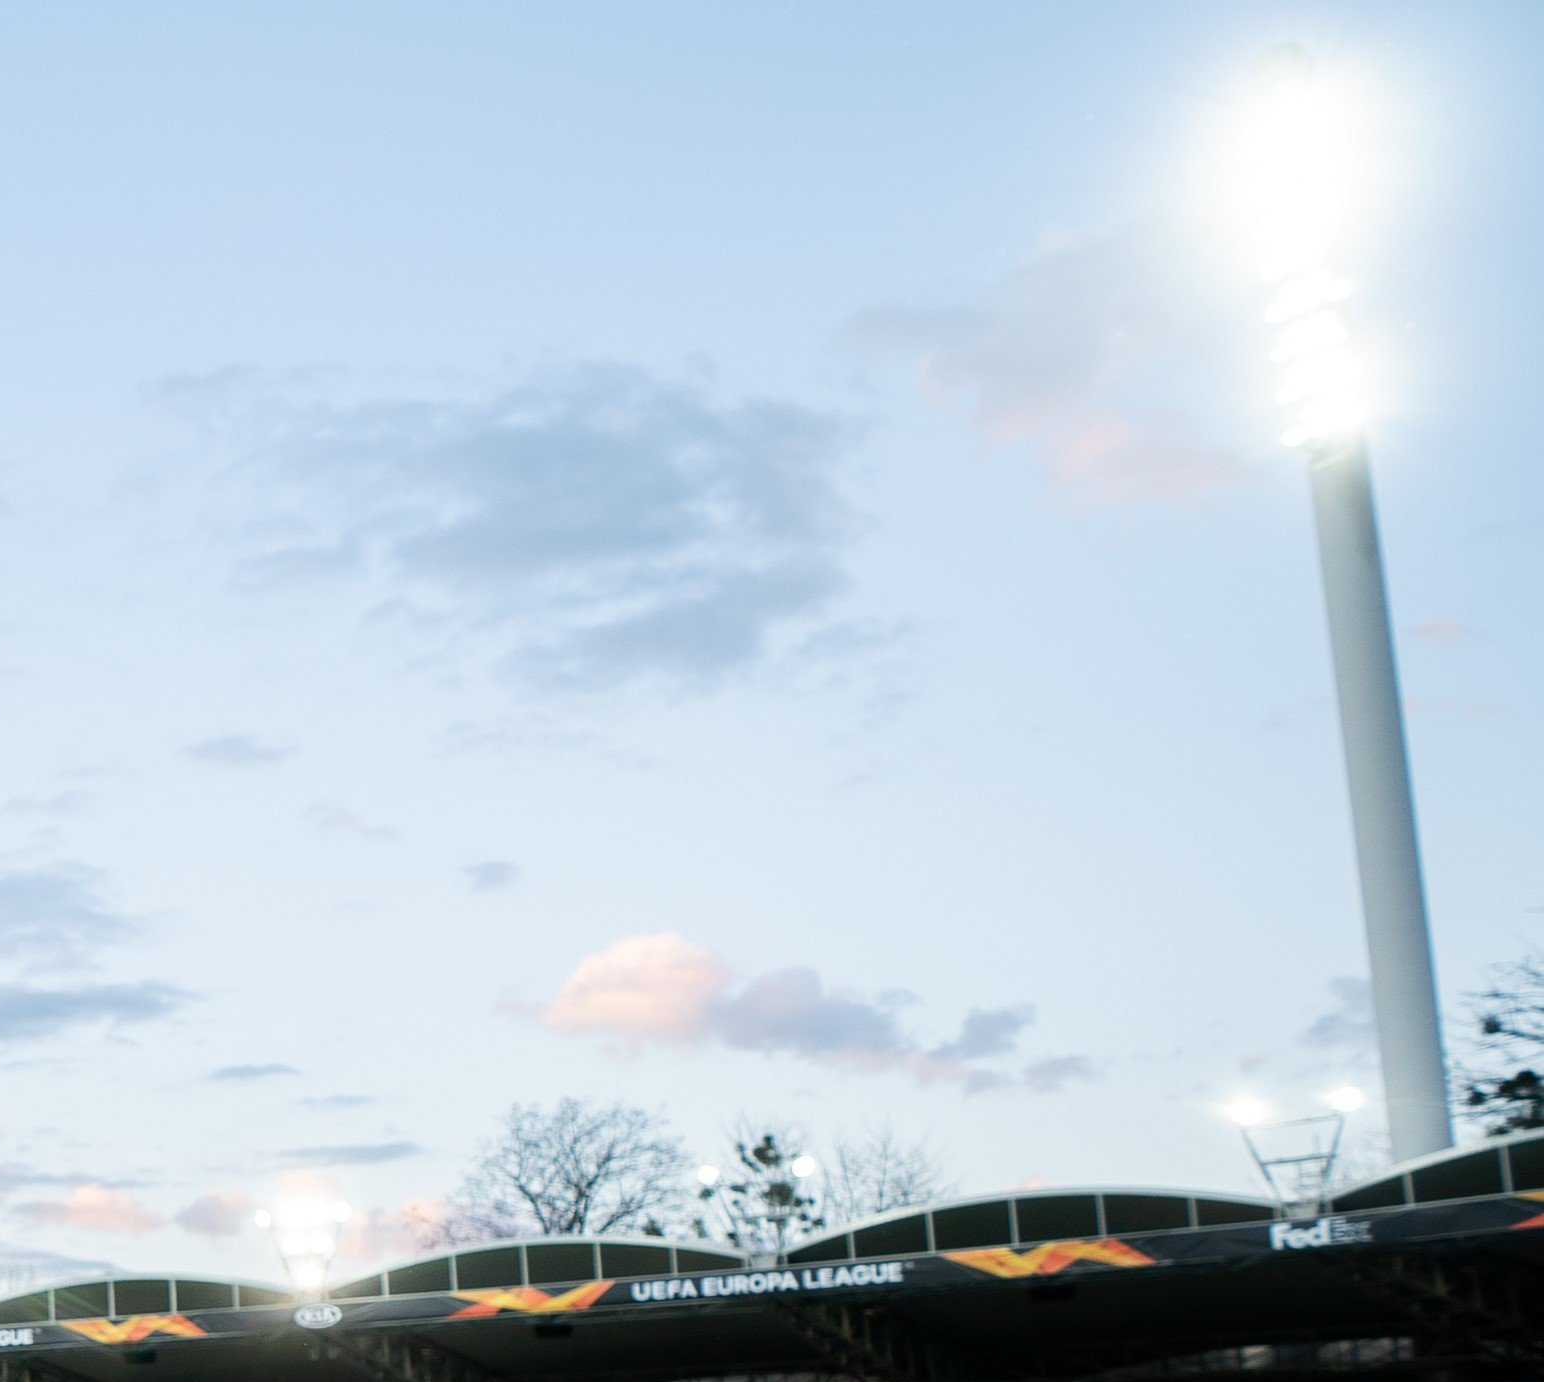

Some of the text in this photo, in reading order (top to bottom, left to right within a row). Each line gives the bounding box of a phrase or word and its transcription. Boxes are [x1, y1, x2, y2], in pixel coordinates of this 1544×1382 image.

[630, 1262, 903, 1301] UEFA EUROPA LEAGUE
